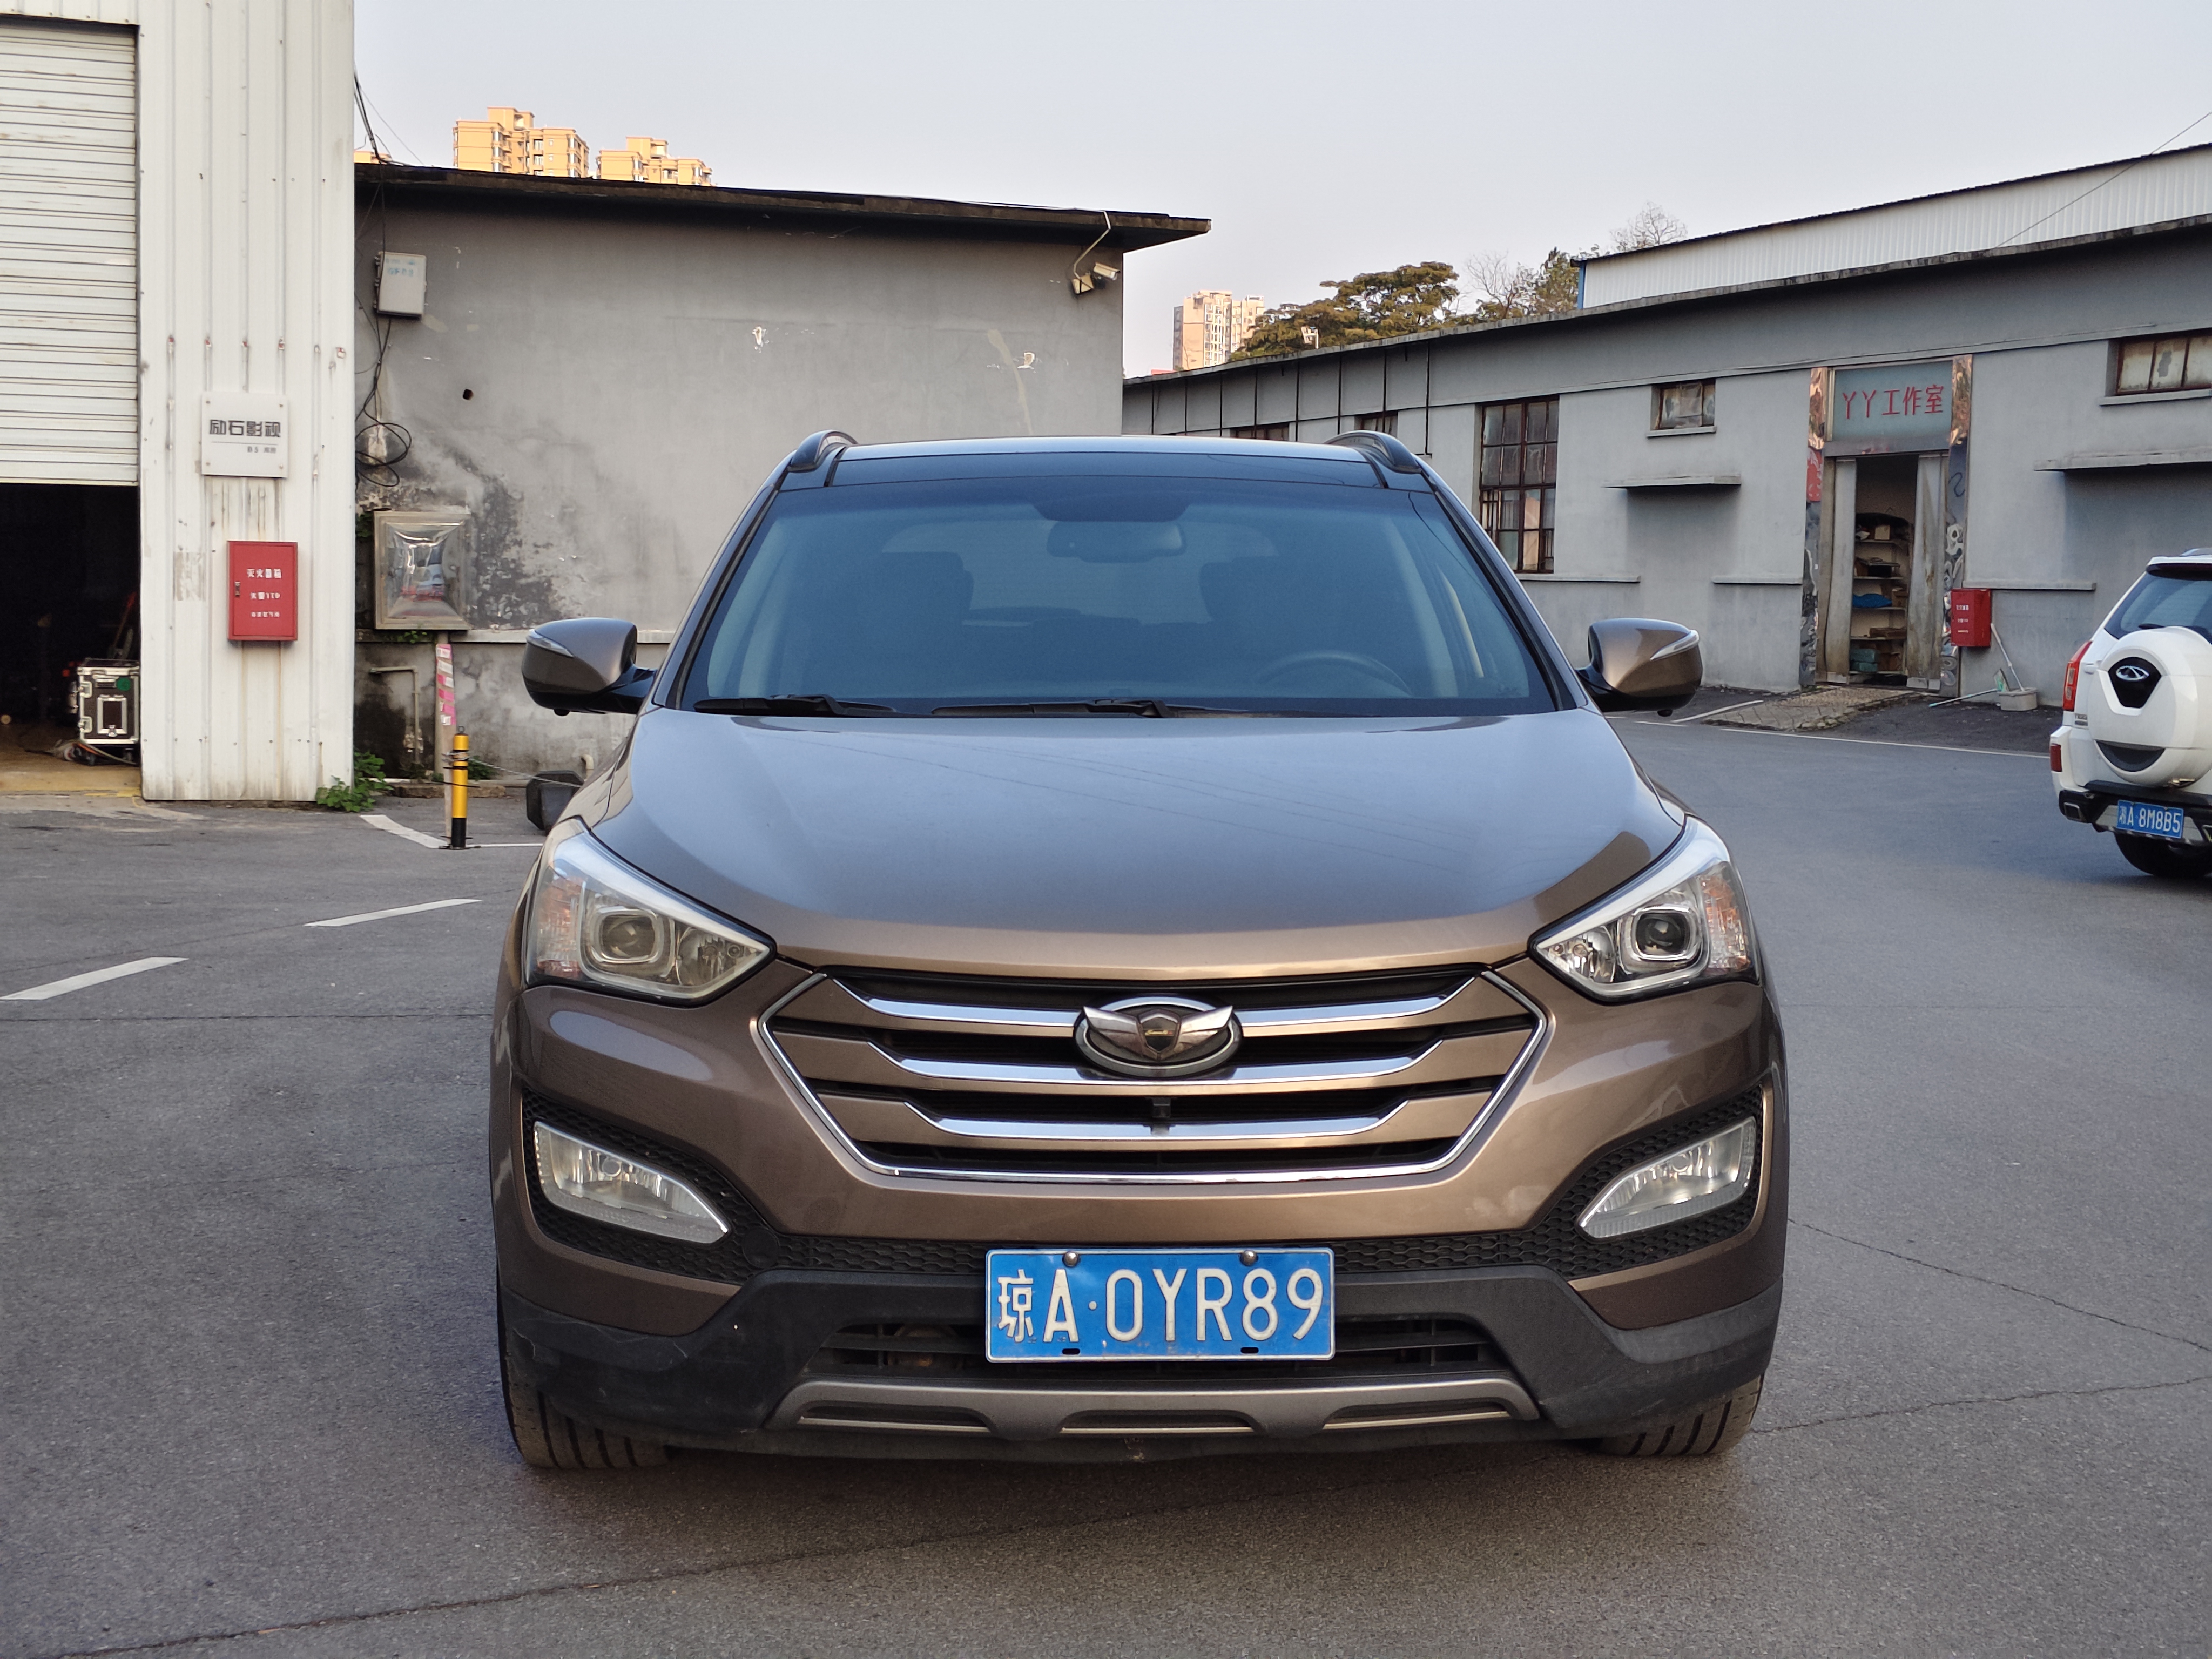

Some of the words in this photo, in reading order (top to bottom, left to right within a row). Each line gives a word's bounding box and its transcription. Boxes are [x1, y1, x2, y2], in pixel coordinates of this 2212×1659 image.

[209, 419, 281, 437] 励石影视
[996, 1267, 1325, 1343] 琼A·0YR89
